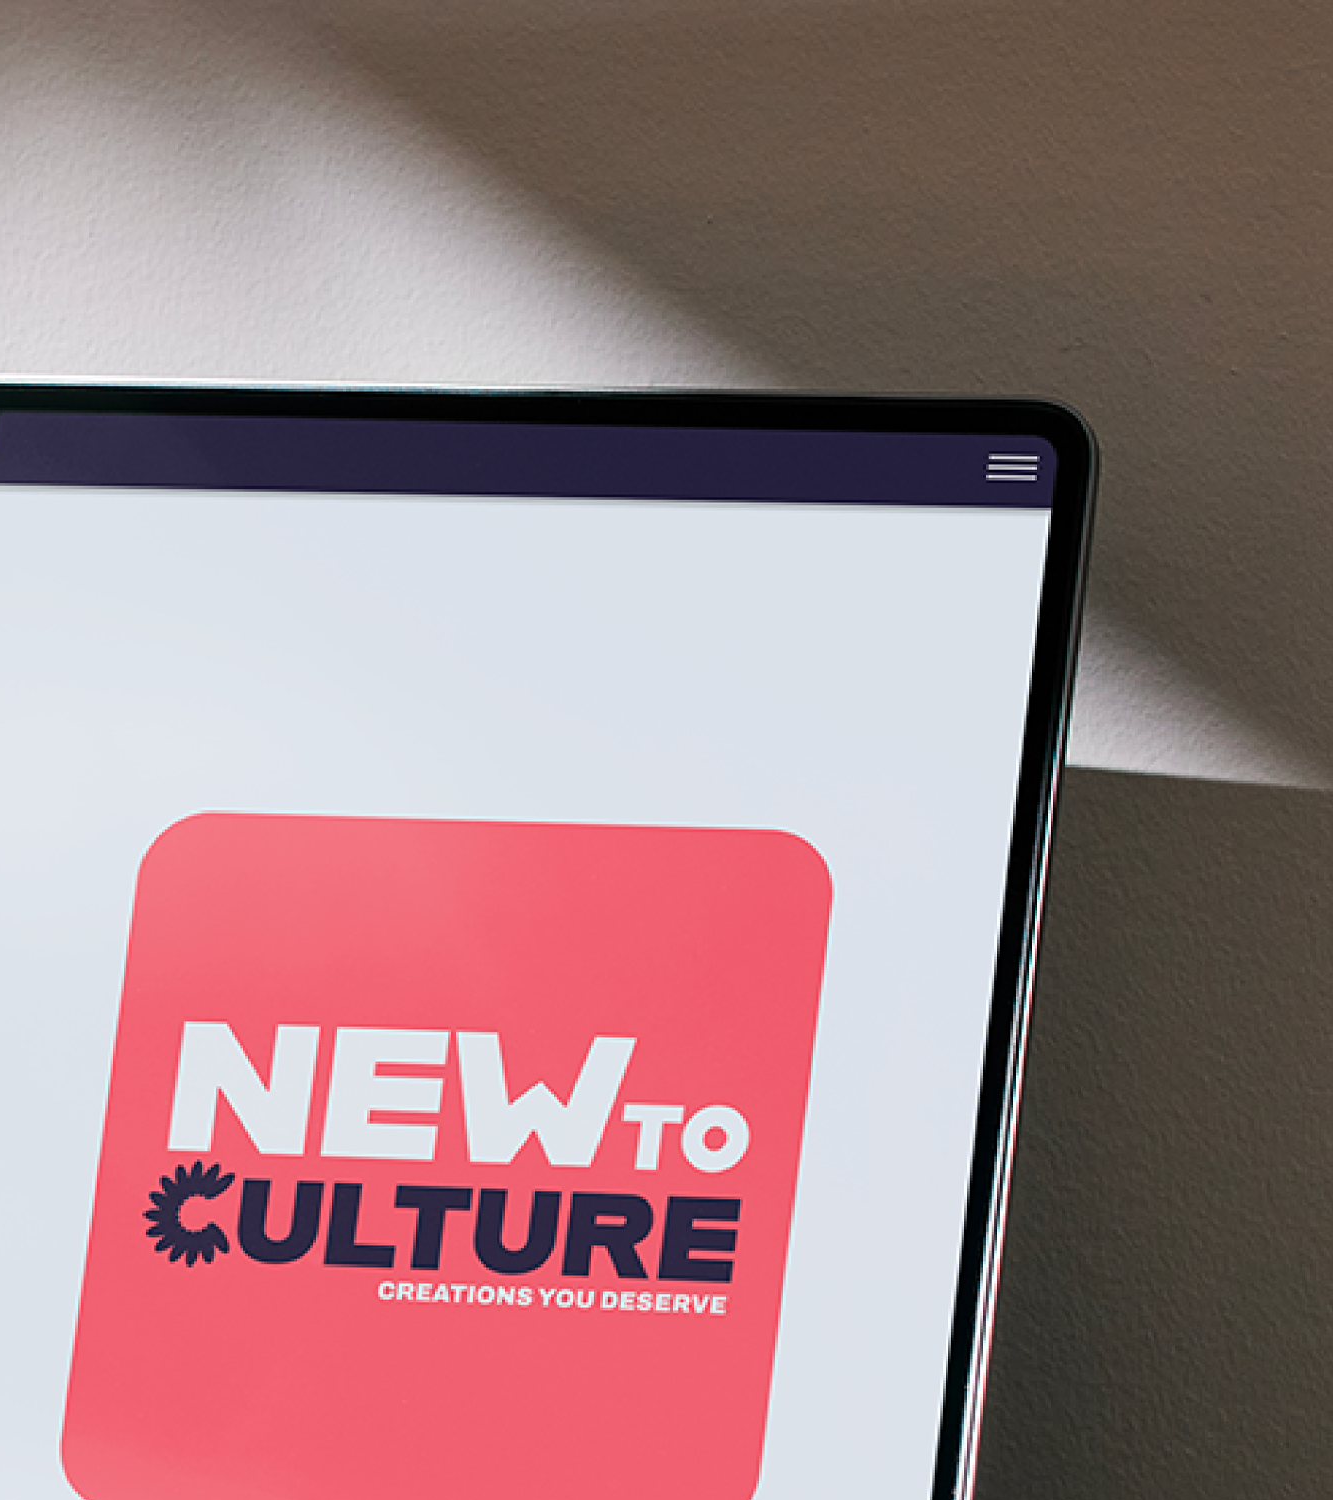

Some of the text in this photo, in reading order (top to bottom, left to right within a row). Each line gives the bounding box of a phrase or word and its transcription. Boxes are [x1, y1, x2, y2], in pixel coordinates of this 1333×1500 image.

[166, 1020, 750, 1173] NEW TO
[141, 1160, 741, 1284] CULTURE
[376, 1280, 727, 1314] CREATIONS YOU DESERVE
